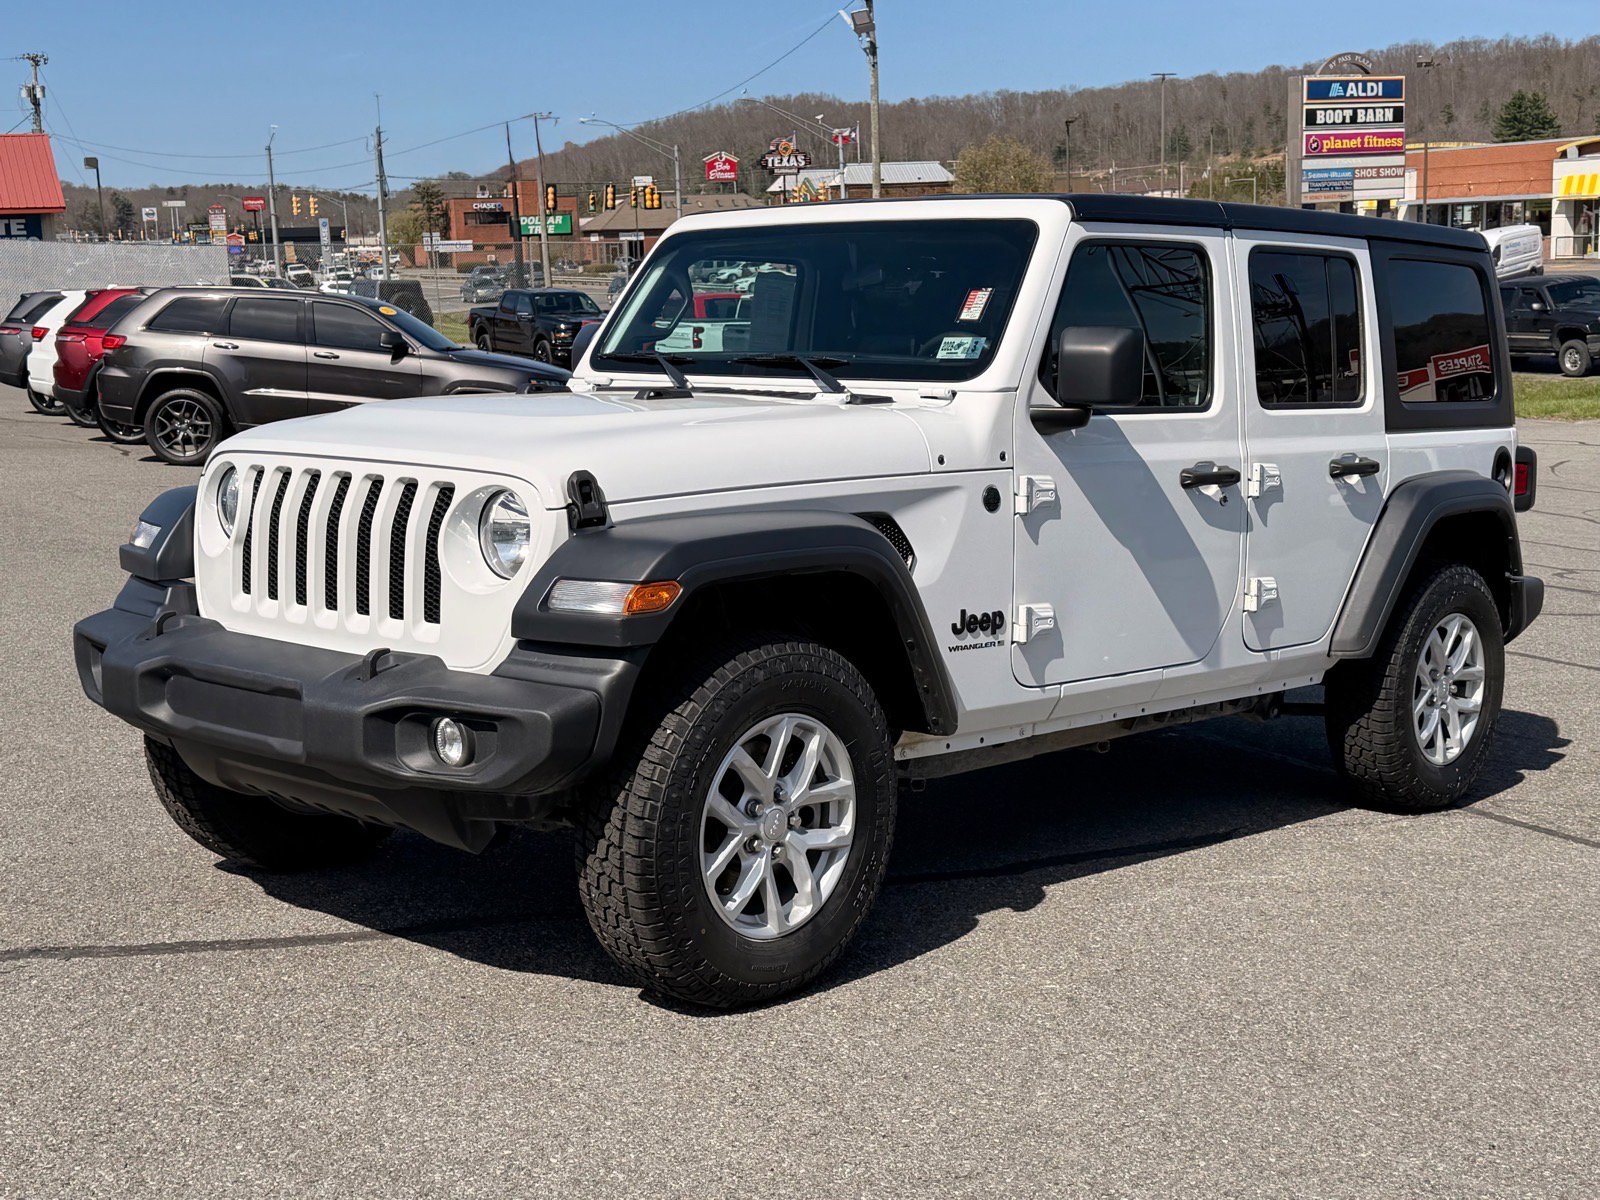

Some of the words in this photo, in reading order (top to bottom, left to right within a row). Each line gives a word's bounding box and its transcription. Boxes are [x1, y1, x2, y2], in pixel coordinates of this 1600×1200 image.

[1329, 60, 1336, 69] BY
[1338, 55, 1351, 63] PASS
[1355, 56, 1372, 68] PLAZA
[1346, 83, 1383, 97] ALDI
[1316, 109, 1353, 124] BOOT
[1357, 108, 1394, 123] BARN
[1322, 136, 1362, 153] planet
[1364, 135, 1403, 148] fitness
[714, 162, 730, 171] Bob
[767, 155, 806, 167] TEXAS
[1354, 168, 1378, 178] SHOE
[1379, 167, 1404, 176] SHOW
[520, 215, 563, 225] DOLAR
[528, 225, 555, 234] TRE
[951, 609, 1005, 636] Jeep
[948, 641, 996, 652] WRANGLER
